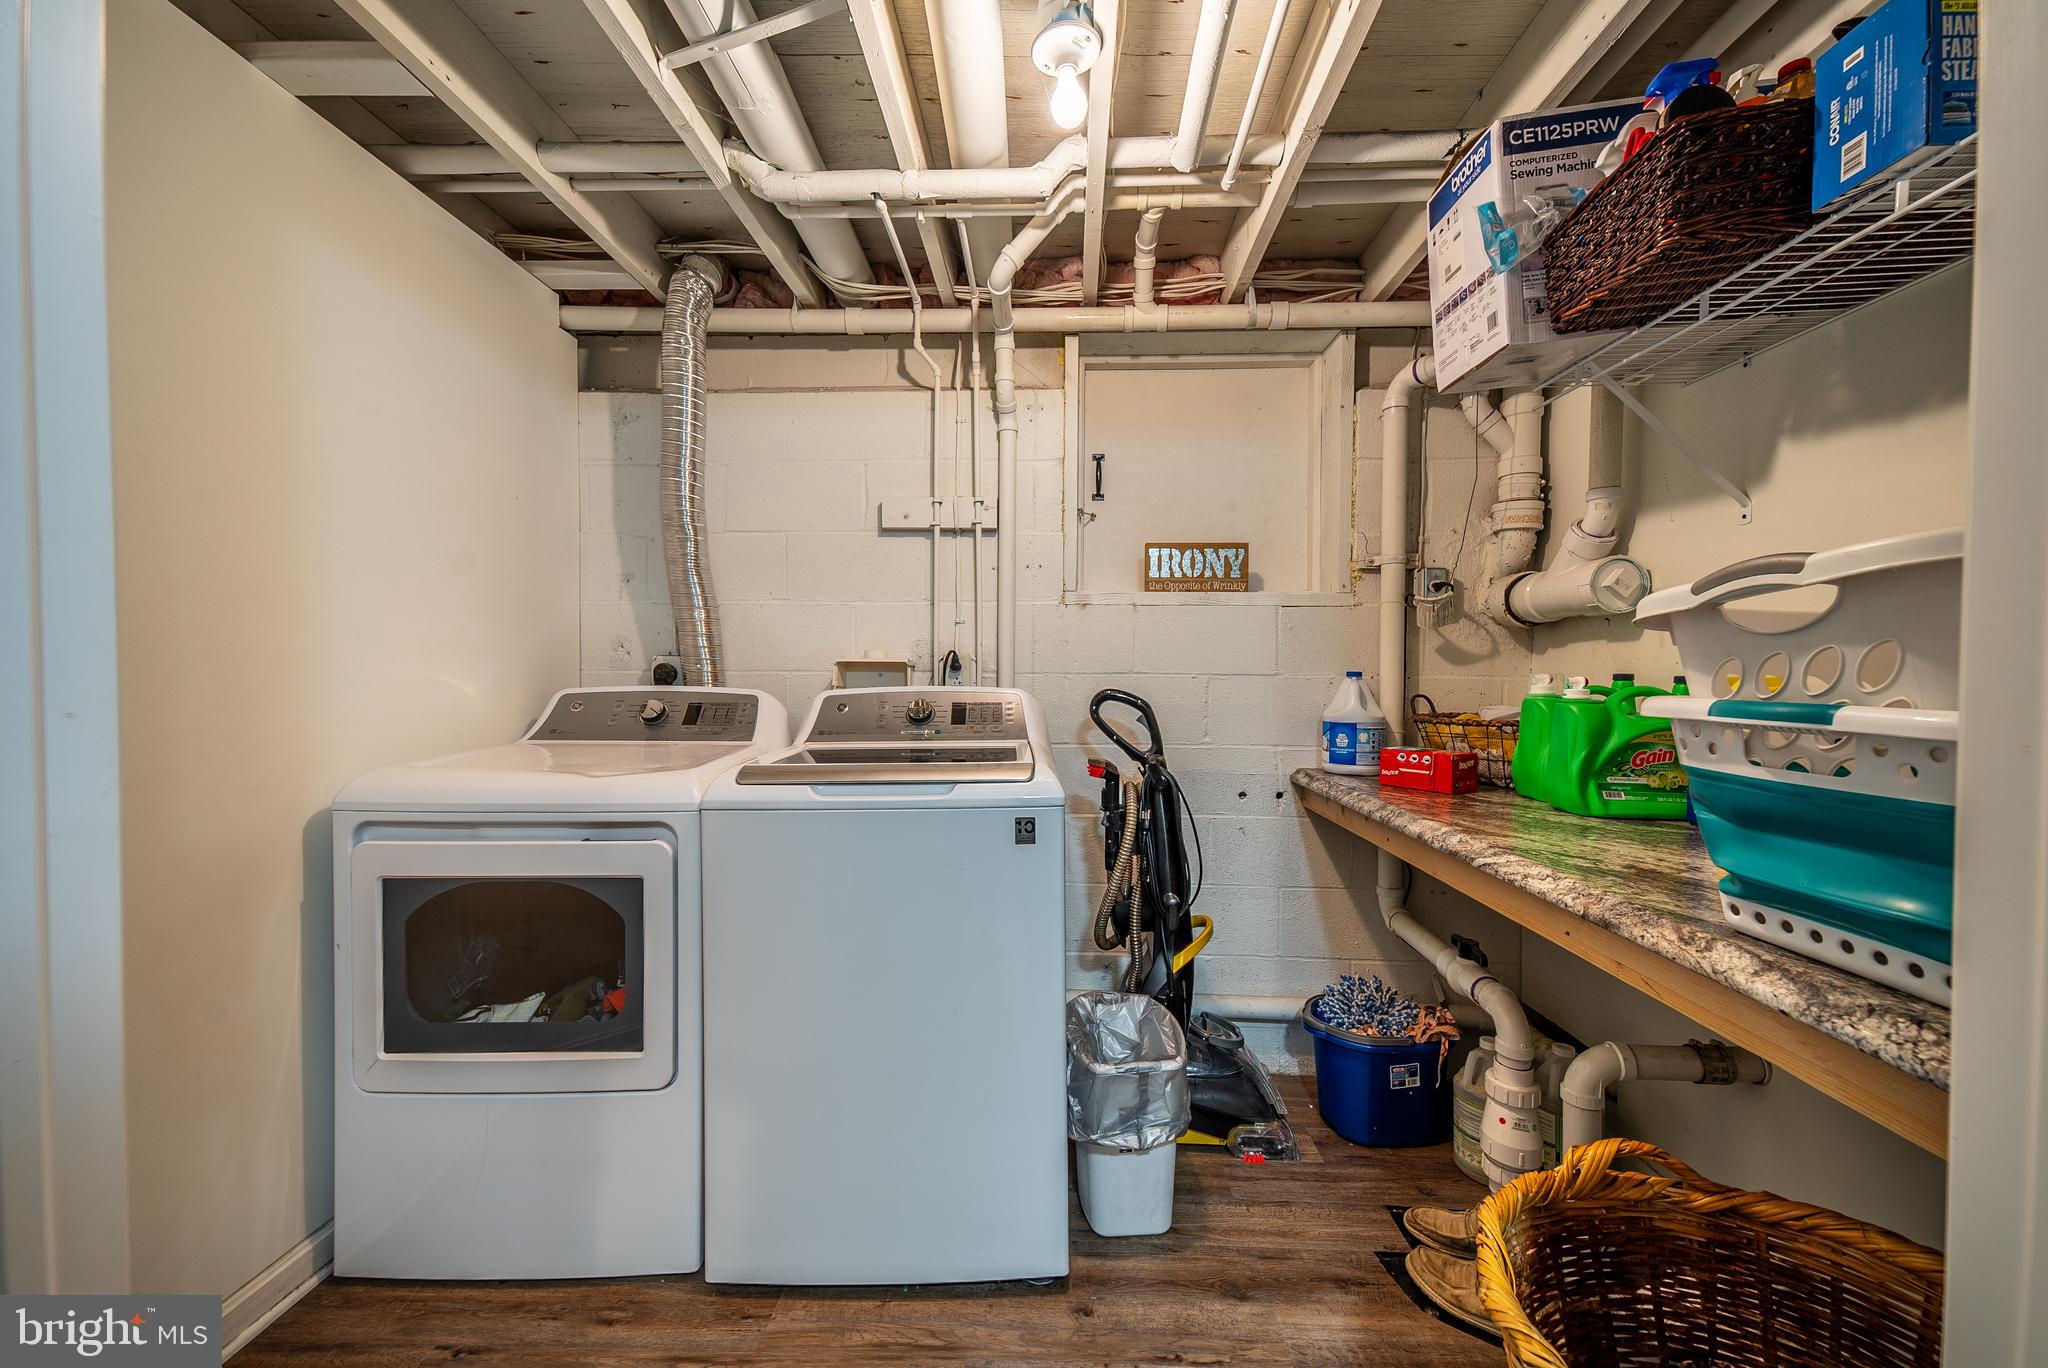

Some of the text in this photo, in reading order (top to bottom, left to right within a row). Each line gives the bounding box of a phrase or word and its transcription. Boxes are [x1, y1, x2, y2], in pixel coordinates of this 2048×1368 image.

[1509, 116, 1620, 145] CE1125PRW
[1829, 96, 1841, 146] CONAIR
[1451, 140, 1488, 193] brother
[1509, 152, 1578, 168] COMPUTERIZED
[1510, 166, 1553, 180] Sewing
[1148, 548, 1246, 578] IRONY
[1149, 581, 1247, 592] the Opposite of Wrinkly
[1630, 747, 1675, 769] Gain
